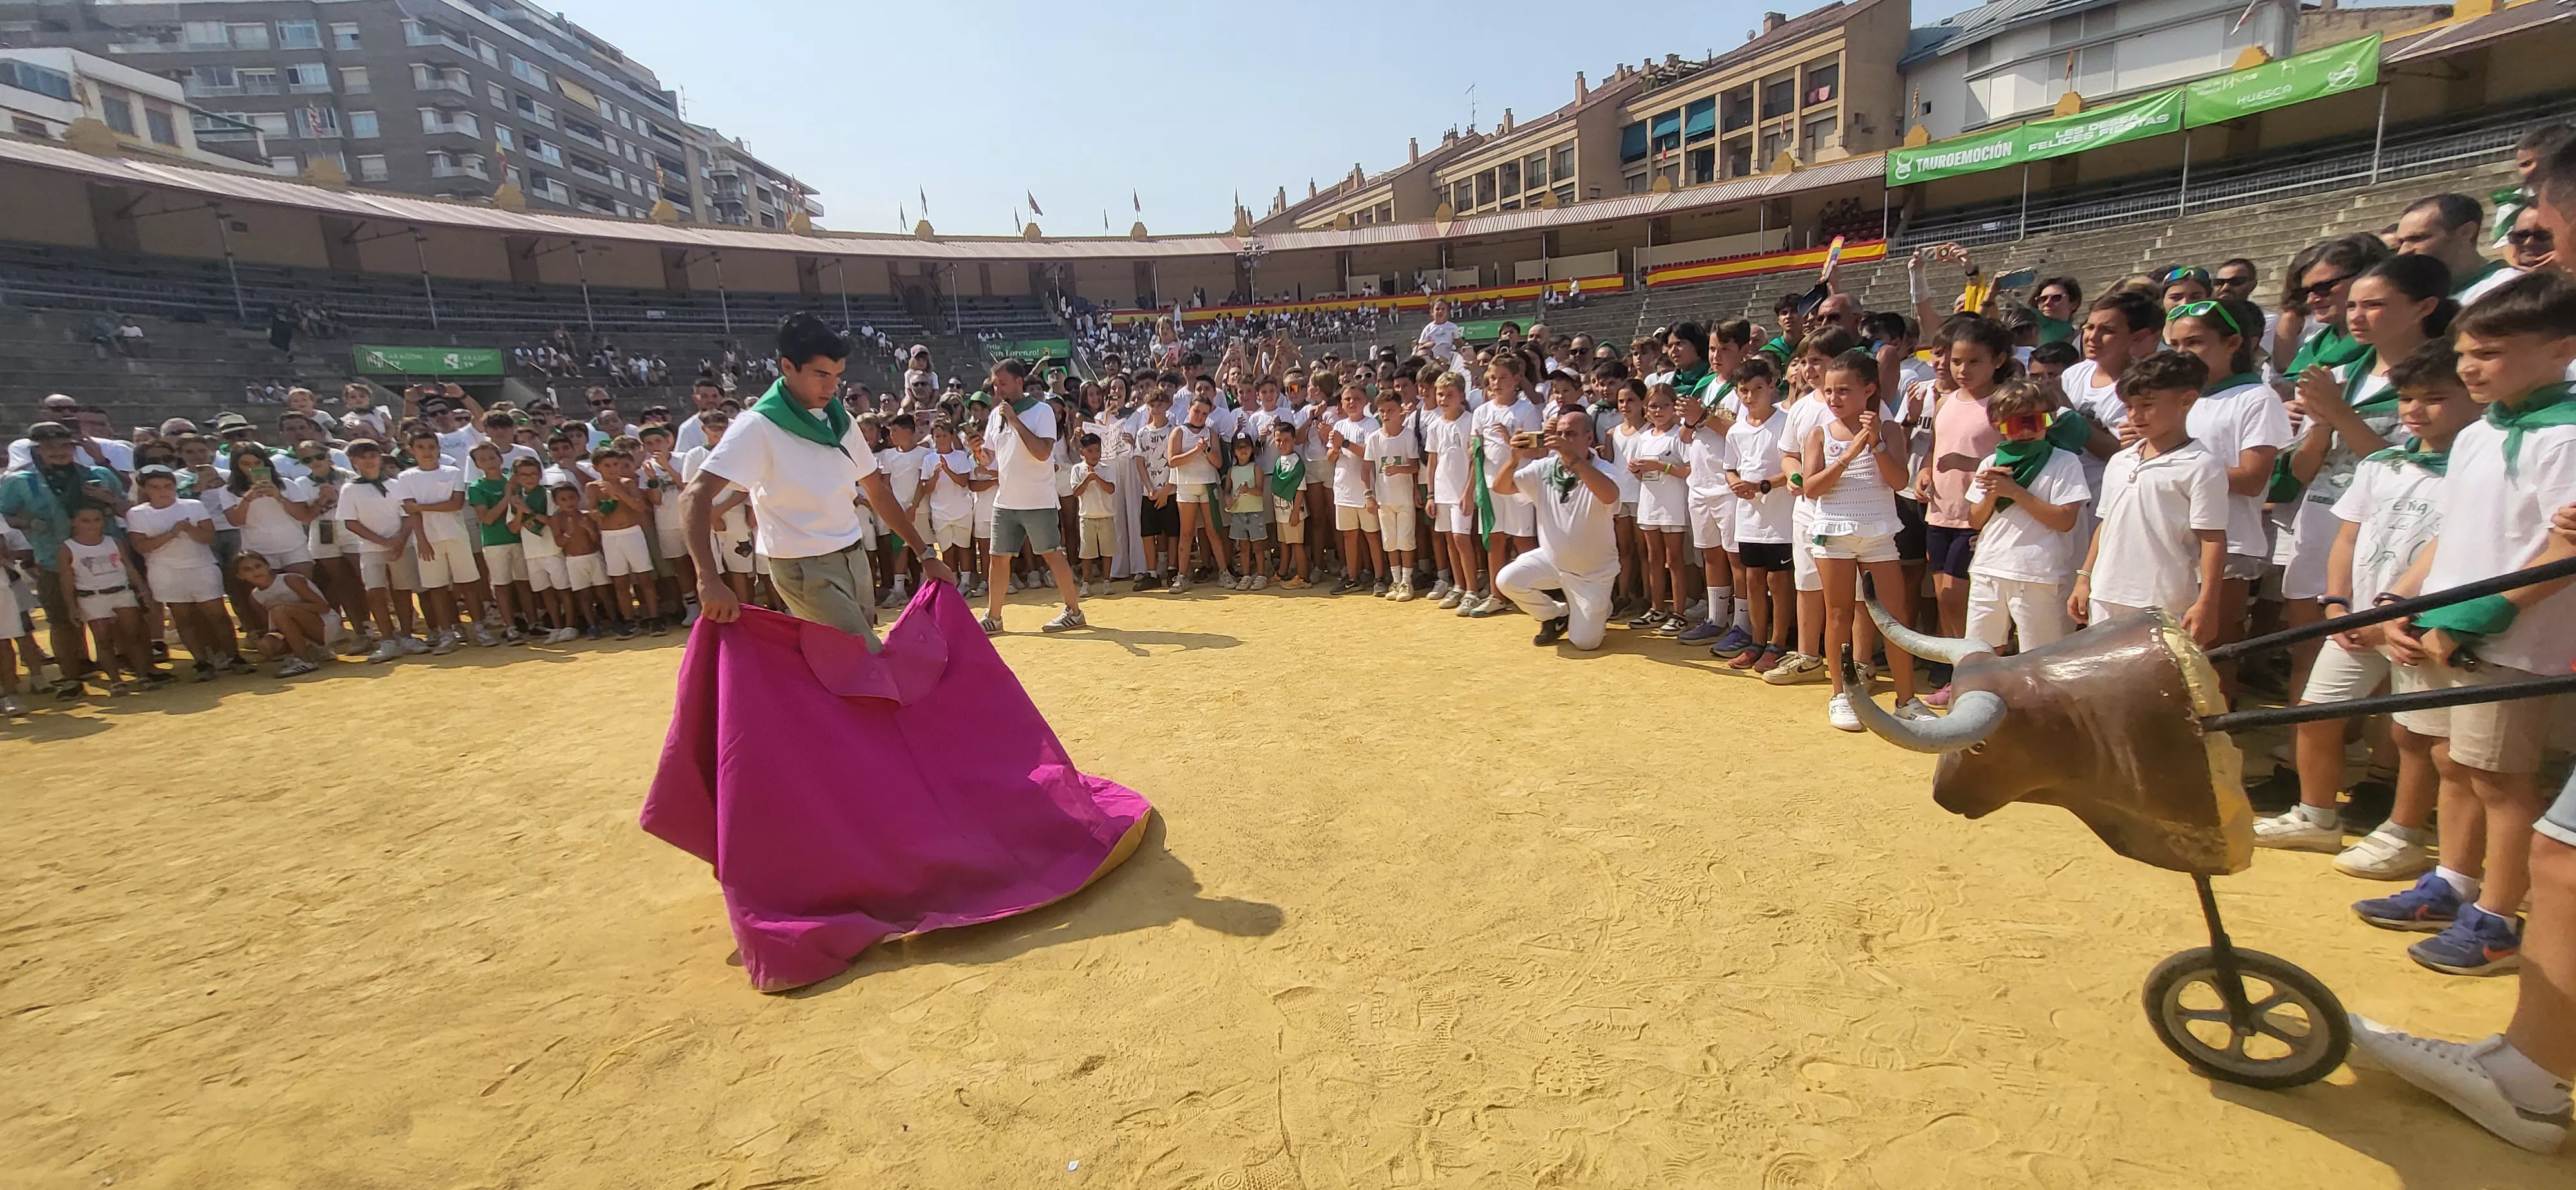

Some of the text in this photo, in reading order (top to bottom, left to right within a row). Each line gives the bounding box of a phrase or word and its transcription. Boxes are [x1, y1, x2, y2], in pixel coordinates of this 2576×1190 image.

[2236, 84, 2292, 105] HUESCA
[2028, 113, 2170, 152] FELICES FIESTAS
[2055, 113, 2139, 139] LES DESEA
[1915, 141, 2012, 173] TAUROEMOCIÓN
